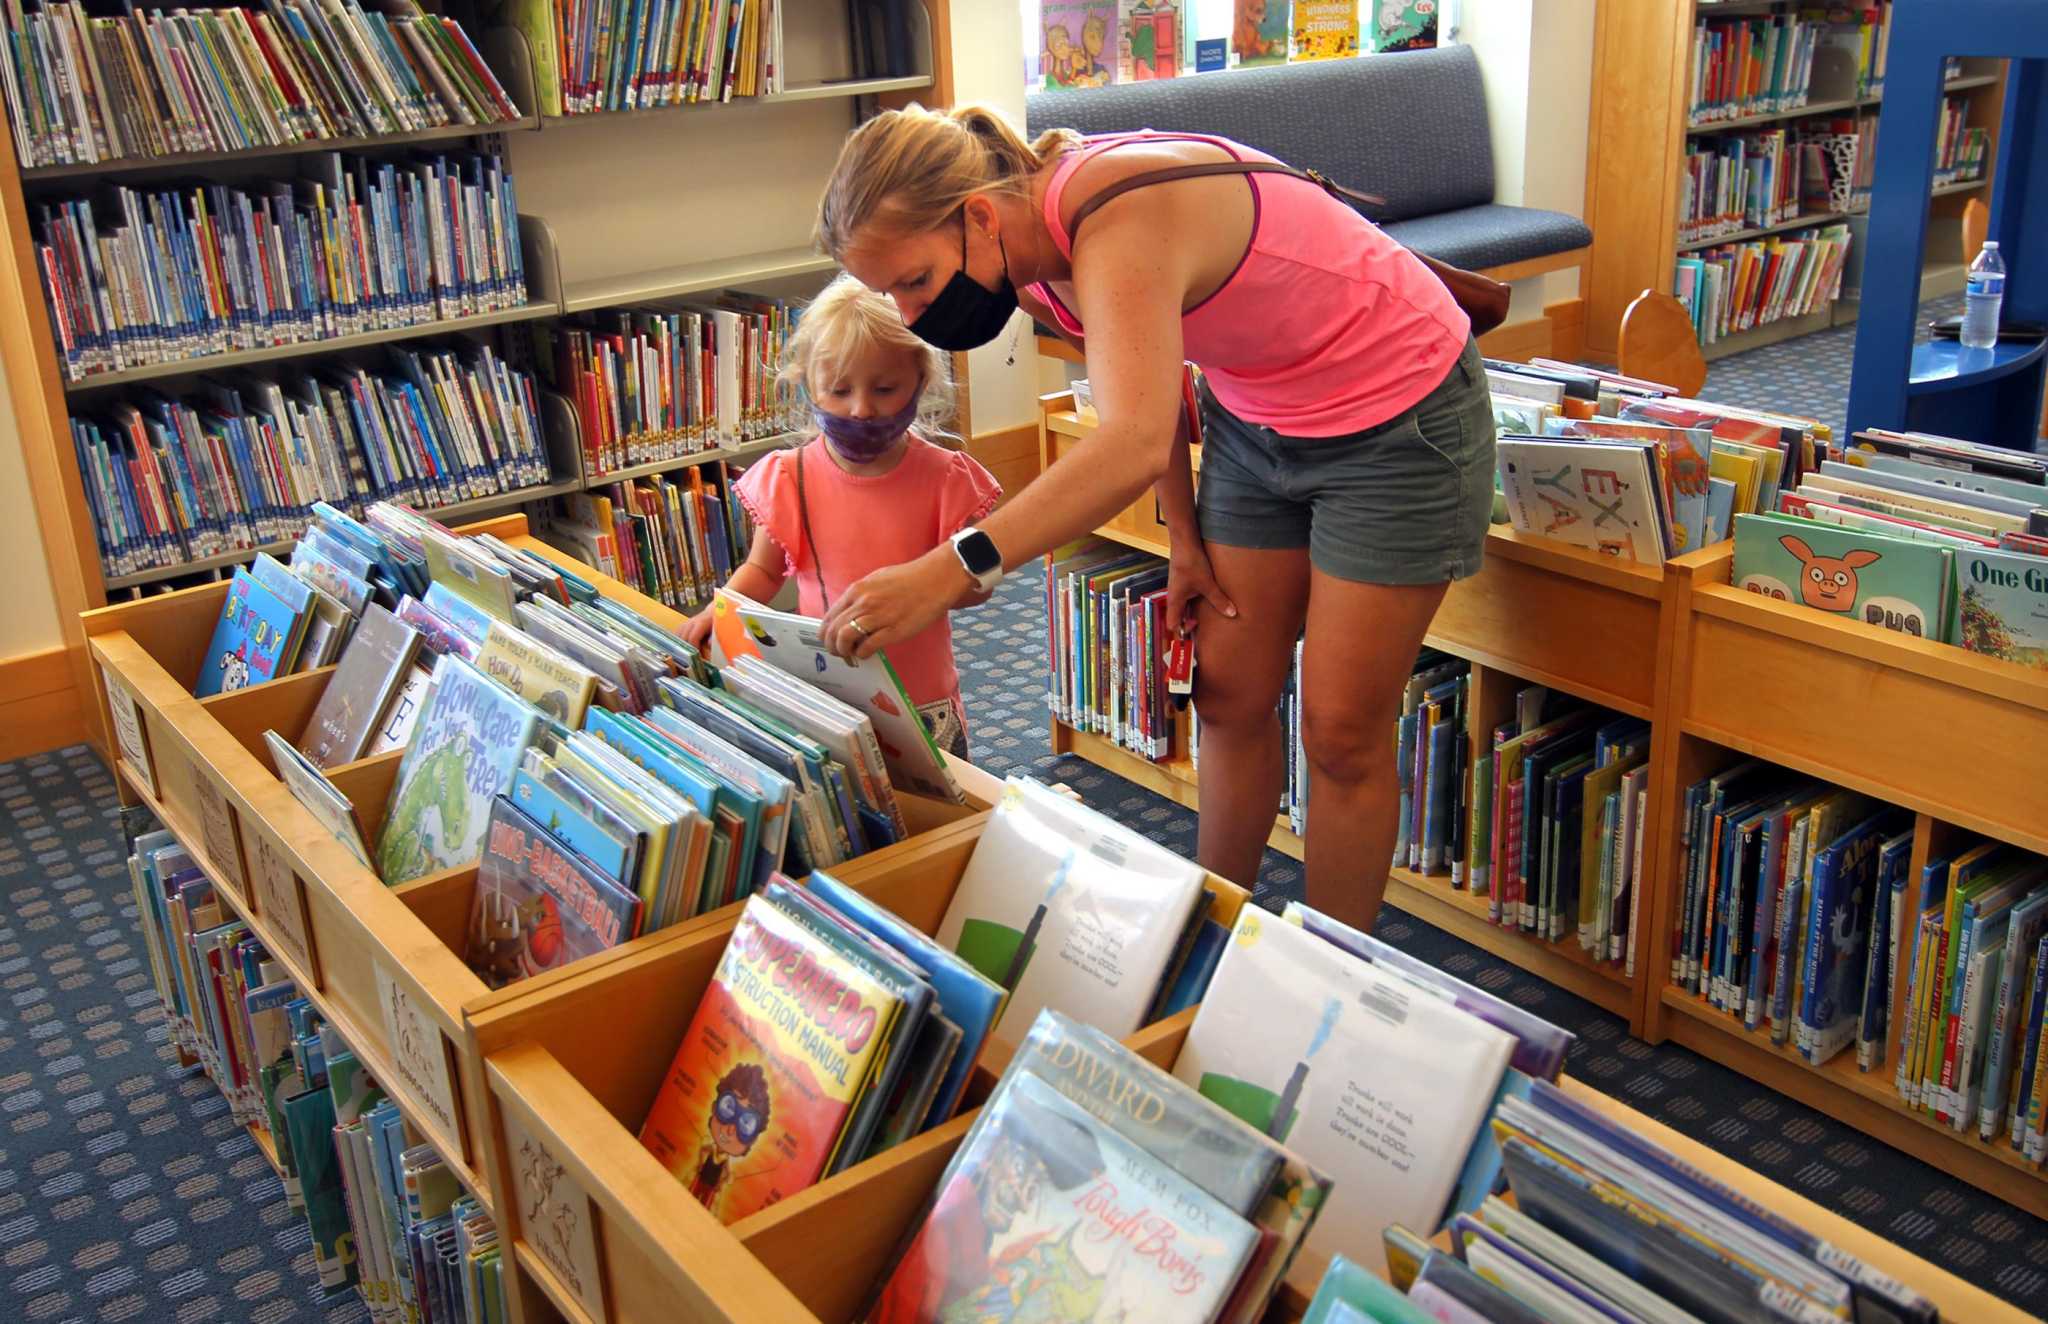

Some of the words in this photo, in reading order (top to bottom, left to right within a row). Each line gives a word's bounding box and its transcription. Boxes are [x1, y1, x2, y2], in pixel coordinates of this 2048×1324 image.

[1306, 19, 1349, 33] STRONG
[1970, 559, 2019, 588] One
[800, 1025, 851, 1086] MANUAL
[1119, 1156, 1168, 1198] MEM
[1171, 1192, 1216, 1232] FOX
[1072, 1168, 1148, 1245] Tough
[1133, 1215, 1206, 1297] Boris
